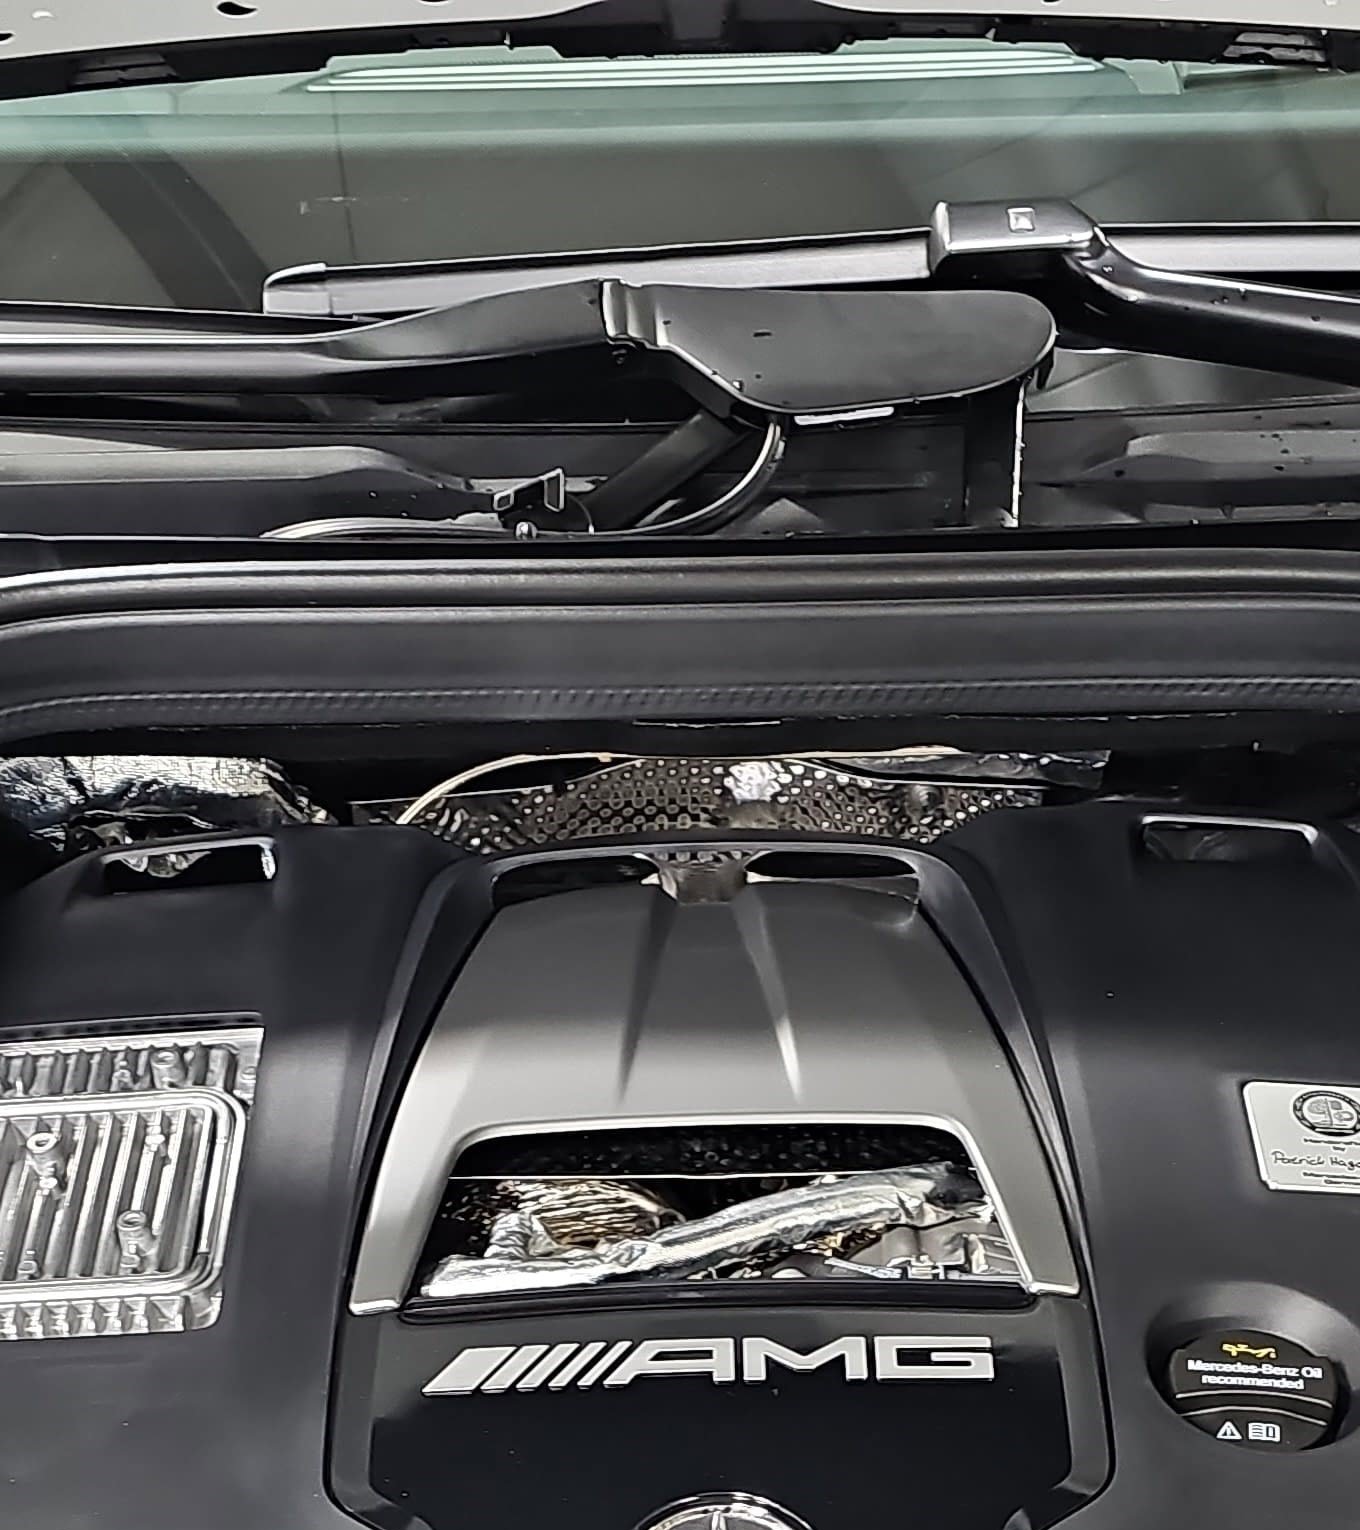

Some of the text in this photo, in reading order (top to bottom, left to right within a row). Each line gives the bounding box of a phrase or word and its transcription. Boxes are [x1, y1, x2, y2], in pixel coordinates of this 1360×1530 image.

[603, 1335, 995, 1389] AMG
[1187, 1359, 1324, 1379] Mercedes-Benz Oil
[1201, 1374, 1305, 1390] recommended
